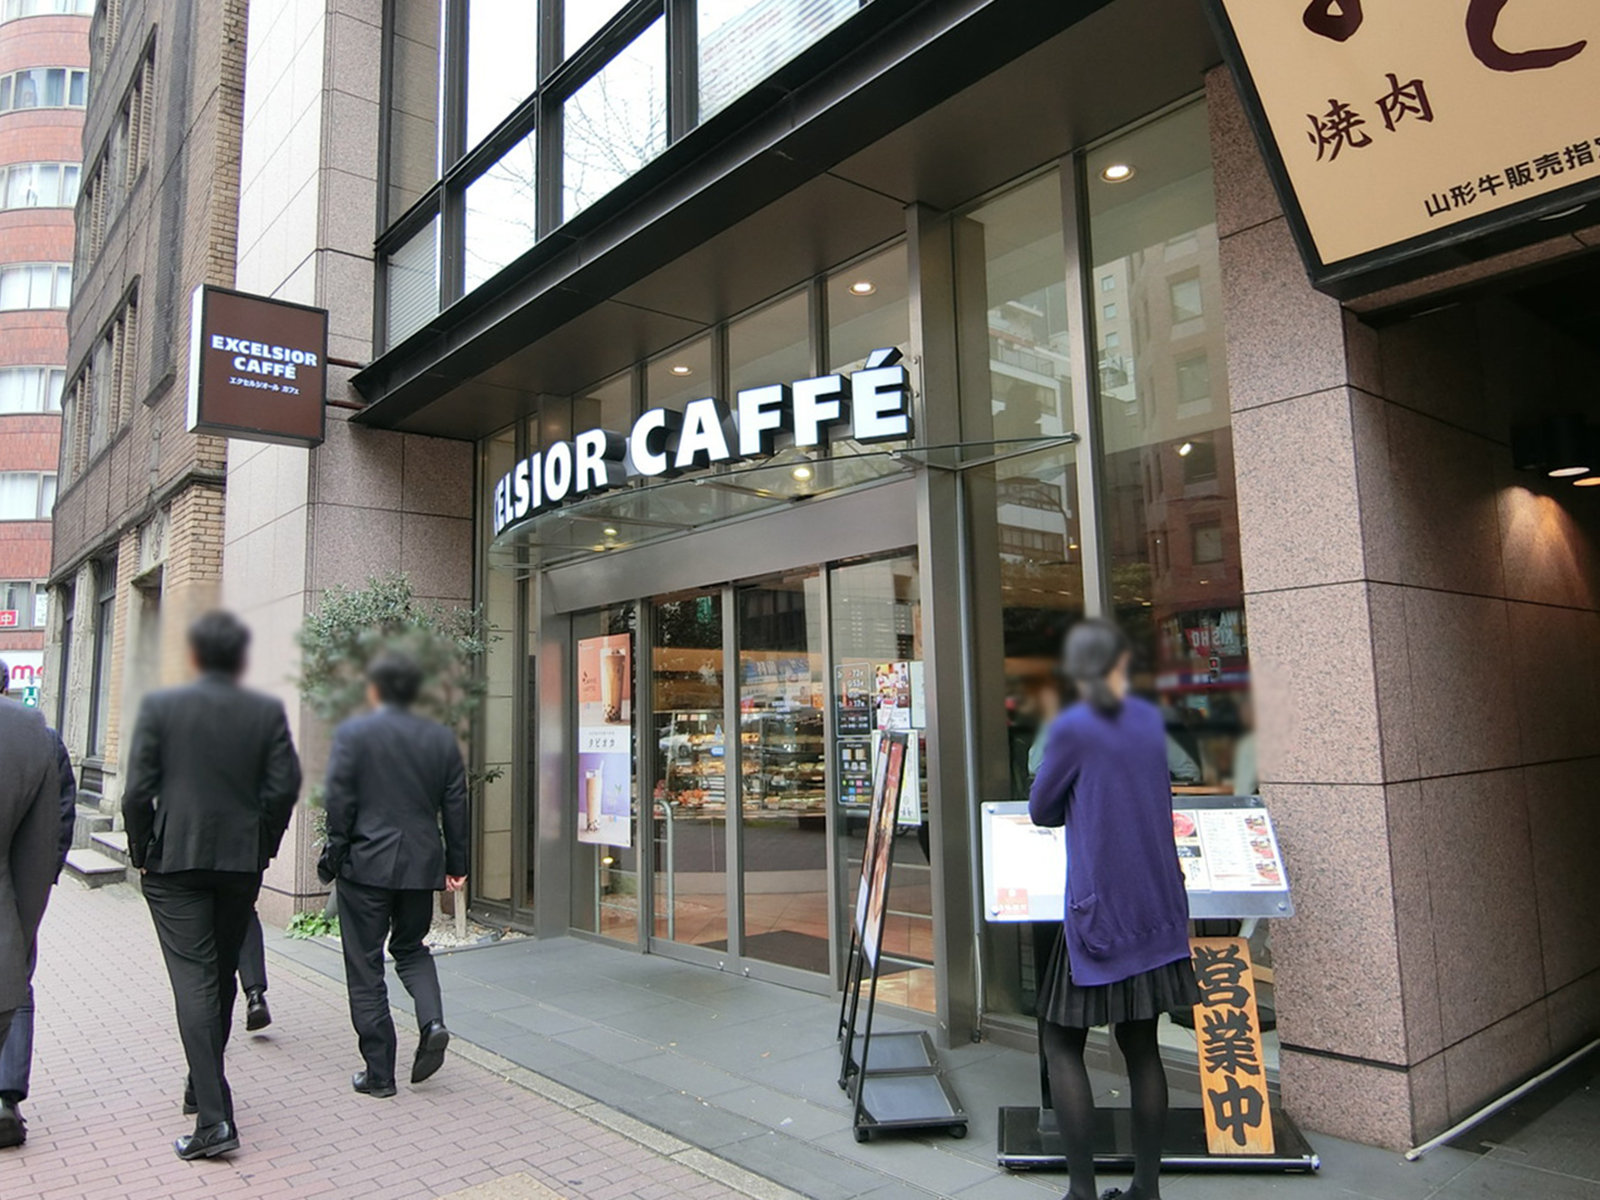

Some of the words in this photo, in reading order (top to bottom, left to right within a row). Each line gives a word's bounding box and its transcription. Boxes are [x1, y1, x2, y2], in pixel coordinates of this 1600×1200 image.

[1306, 73, 1434, 162] 焼肉
[1424, 137, 1600, 218] 山形牛販売指
[211, 334, 318, 367] EXCELSIOR
[233, 356, 297, 380] CAFFÉ
[494, 429, 610, 537] ELSIOR
[630, 346, 911, 477] CAFFÉ
[1193, 944, 1265, 1147] 営業中
